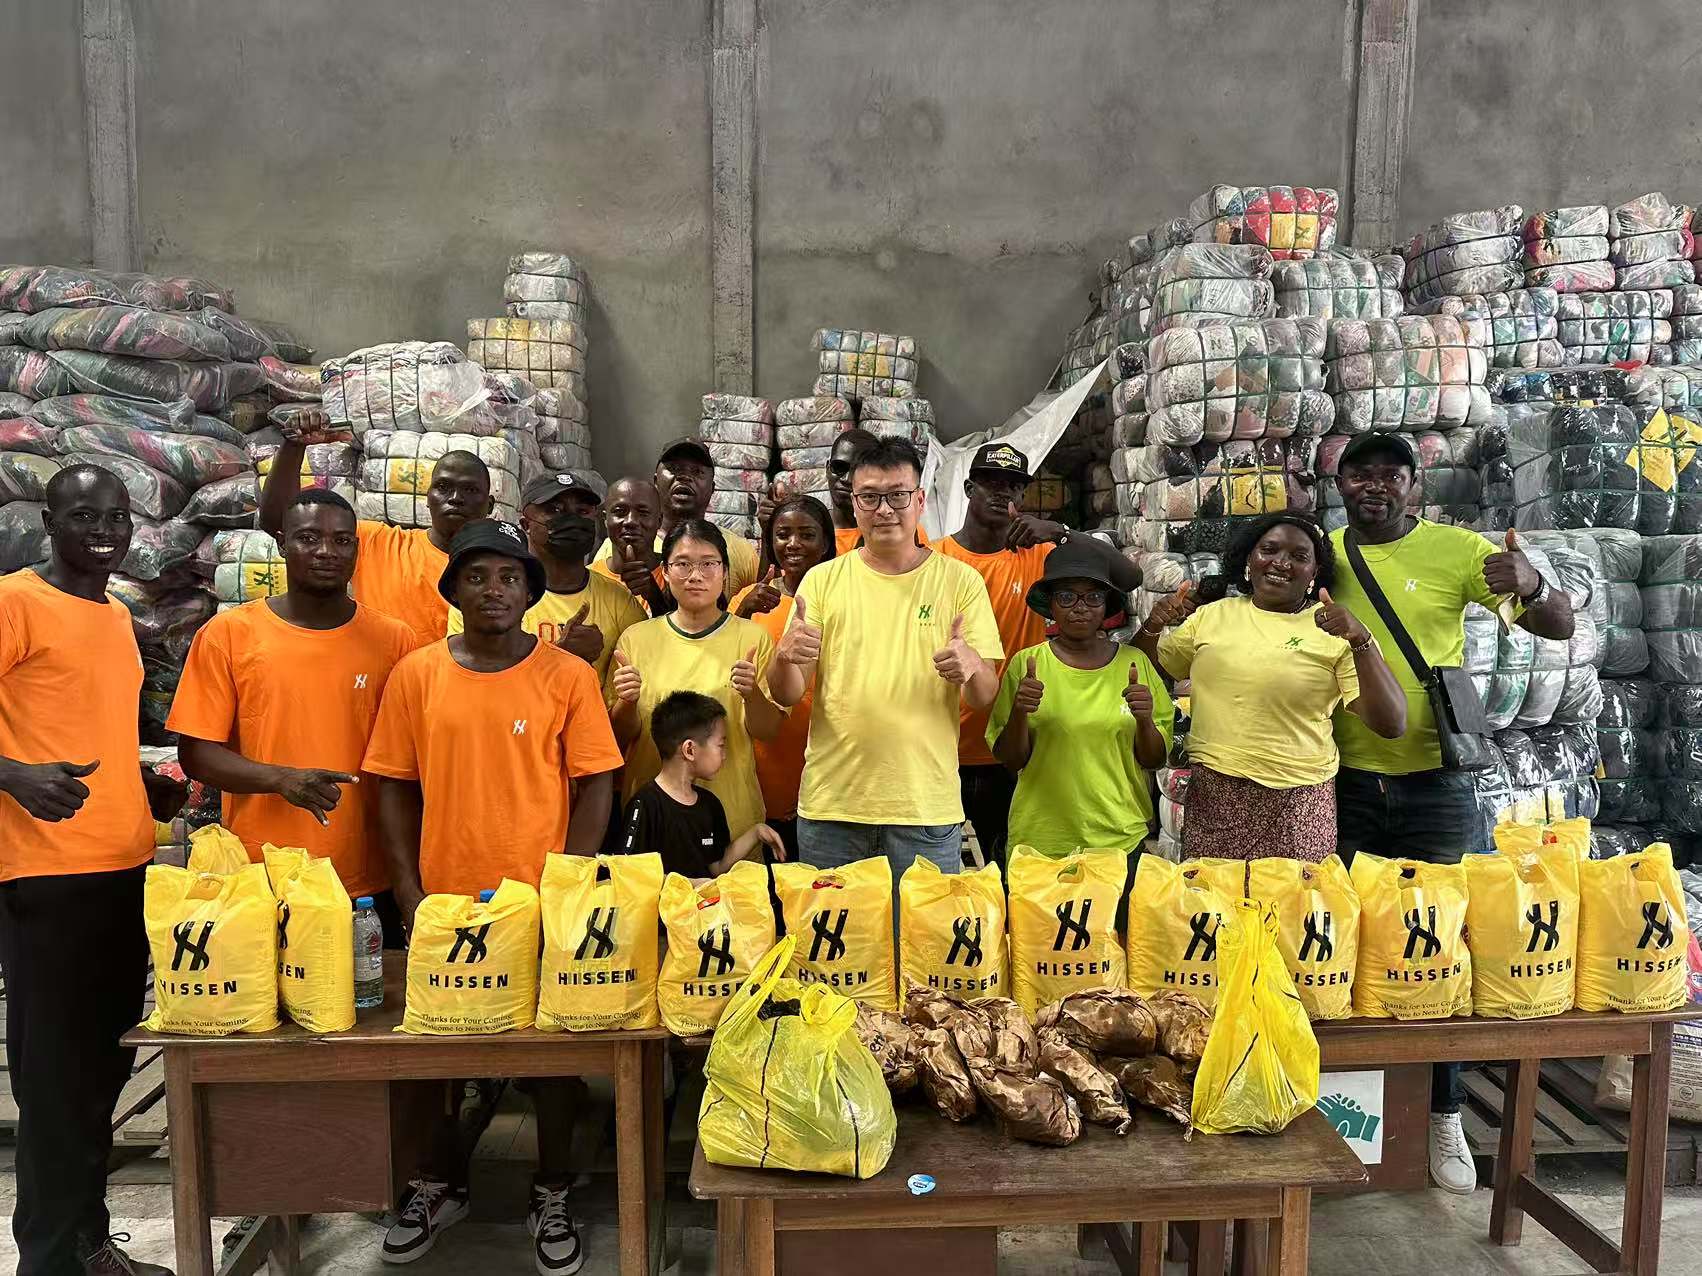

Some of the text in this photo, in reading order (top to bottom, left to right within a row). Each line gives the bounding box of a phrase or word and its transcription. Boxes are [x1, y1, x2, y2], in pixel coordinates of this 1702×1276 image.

[278, 962, 305, 980] SEN
[1037, 959, 1111, 977] HISSEN
[1387, 962, 1462, 982] HISSEN
[1510, 957, 1573, 978] HISSEN
[1617, 955, 1682, 973] HISSEN
[429, 974, 509, 989] HISSEN
[558, 968, 638, 986] HISSEN
[799, 967, 868, 987] HISSEN
[928, 972, 998, 991] HISSEN
[1164, 970, 1218, 987] HISS
[1294, 970, 1349, 987] ISSEN
[422, 1014, 448, 1024] Thanks
[449, 1016, 461, 1024] for
[463, 1017, 482, 1025] Your
